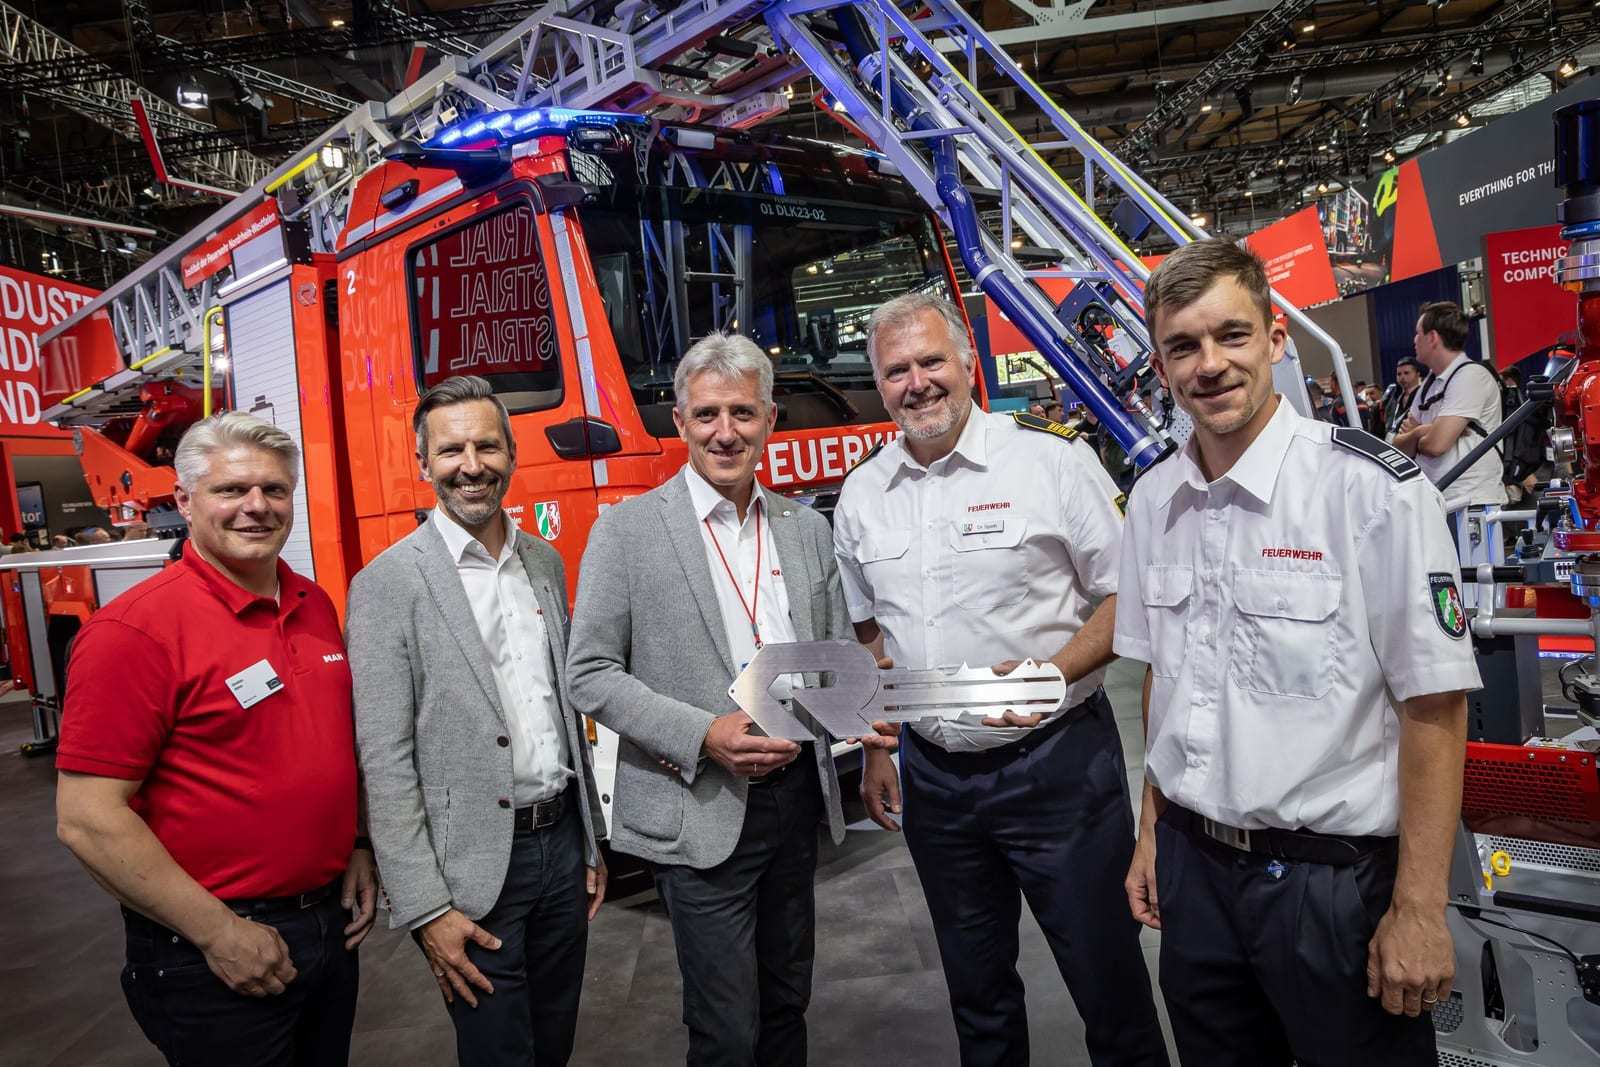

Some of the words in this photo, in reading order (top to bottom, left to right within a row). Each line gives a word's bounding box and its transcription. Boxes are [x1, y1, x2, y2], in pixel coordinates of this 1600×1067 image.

[1459, 175, 1514, 207] EVERYTHING
[1516, 167, 1536, 185] FOR
[776, 204, 827, 221] DLK23-02
[206, 243, 229, 264] Feuerwehr
[228, 212, 276, 250] Nordrhein-Westfalen
[347, 269, 357, 296] 2
[968, 502, 1010, 512] FEUERWEHR
[1262, 548, 1323, 561] FEUERWEHR
